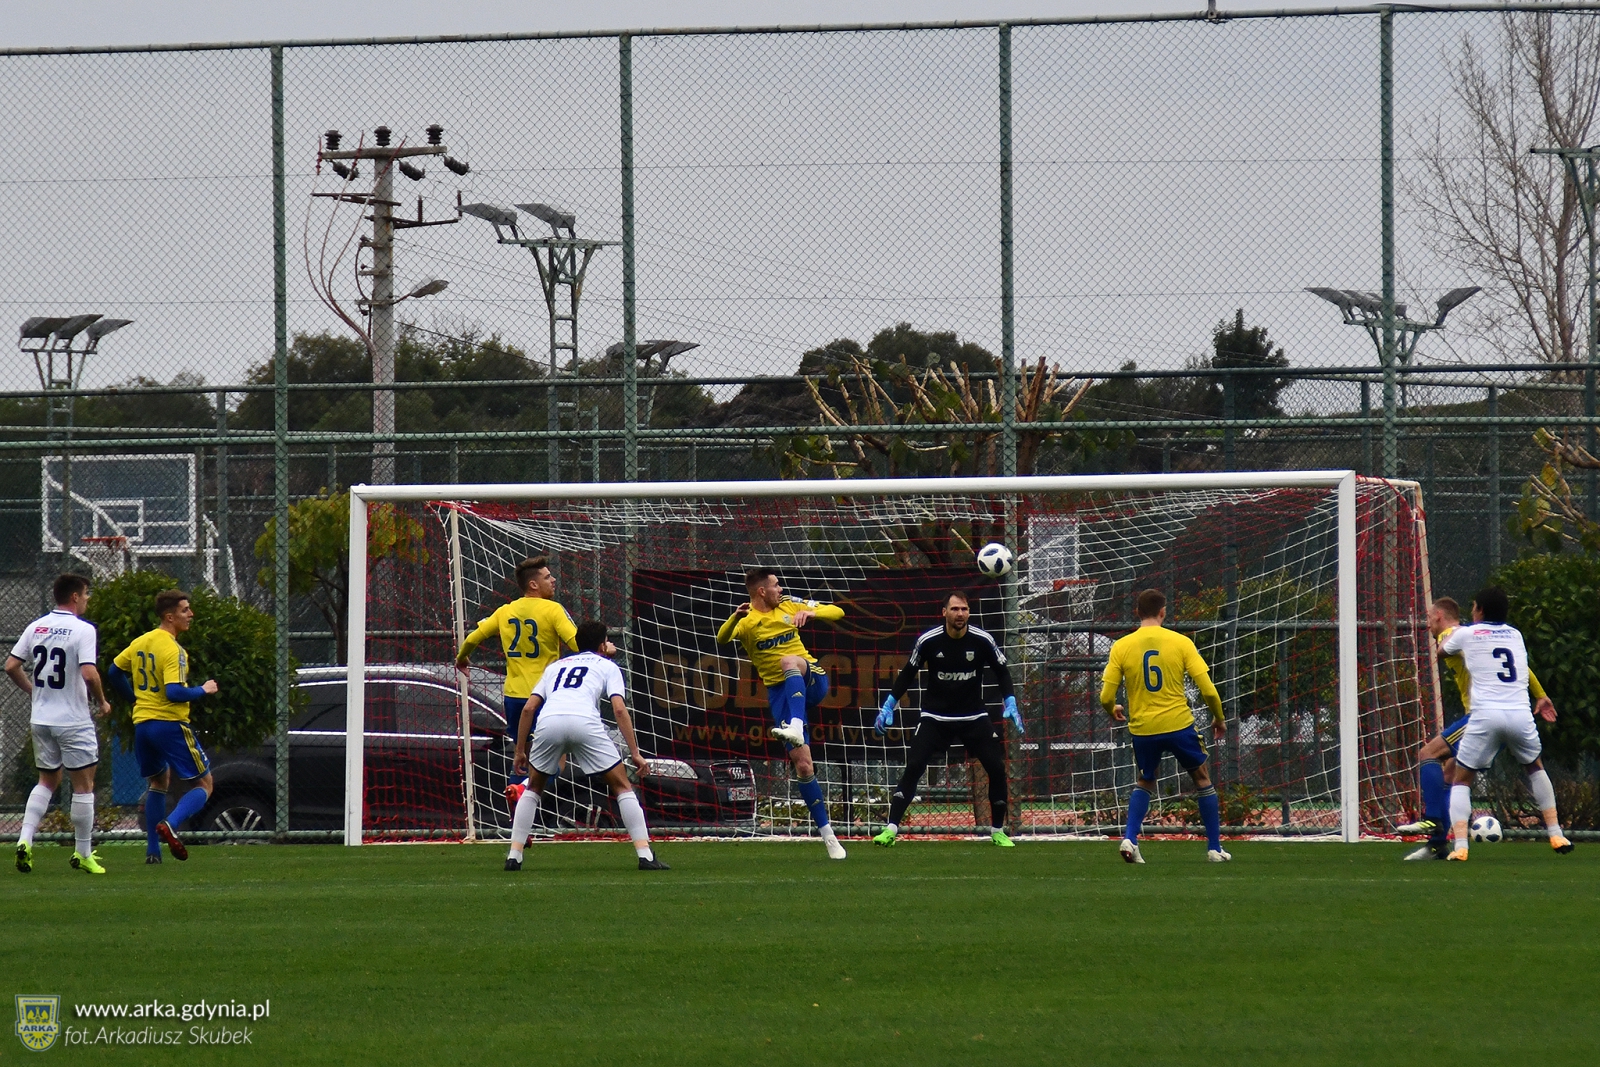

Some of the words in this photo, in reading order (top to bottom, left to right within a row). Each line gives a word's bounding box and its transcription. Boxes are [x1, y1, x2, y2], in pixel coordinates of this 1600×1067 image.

[49, 628, 73, 636] ASSET
[507, 618, 540, 659] 23
[756, 630, 796, 651] GDYNI
[33, 645, 66, 690] 23
[137, 651, 160, 693] 33
[552, 666, 589, 693] 18
[653, 653, 770, 709] GOL
[819, 653, 929, 709] CIT
[1143, 650, 1163, 692] 6
[1492, 647, 1518, 683] 3
